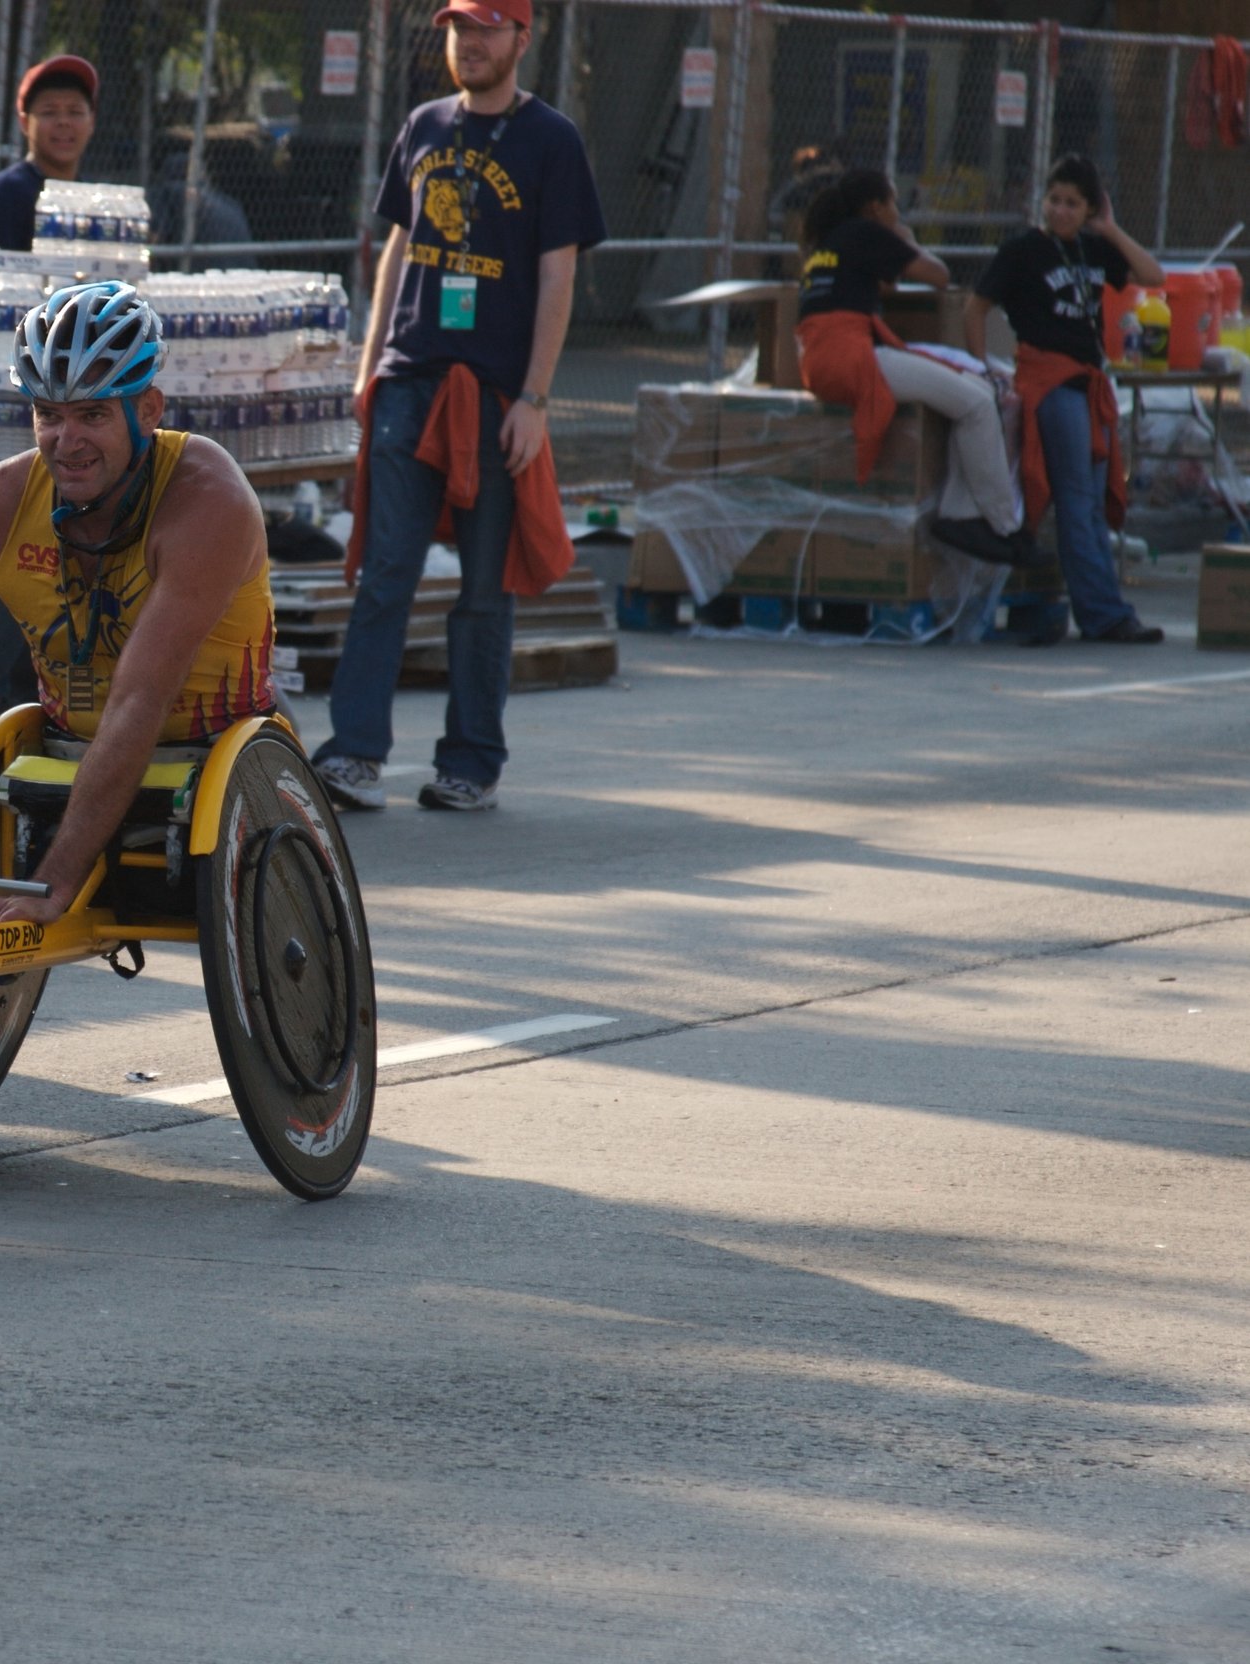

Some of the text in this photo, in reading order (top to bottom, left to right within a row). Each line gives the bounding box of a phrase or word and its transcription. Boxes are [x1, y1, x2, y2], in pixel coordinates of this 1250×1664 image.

[18, 543, 60, 565] CVS
[17, 563, 58, 577] pharmacy
[22, 923, 45, 947] END
